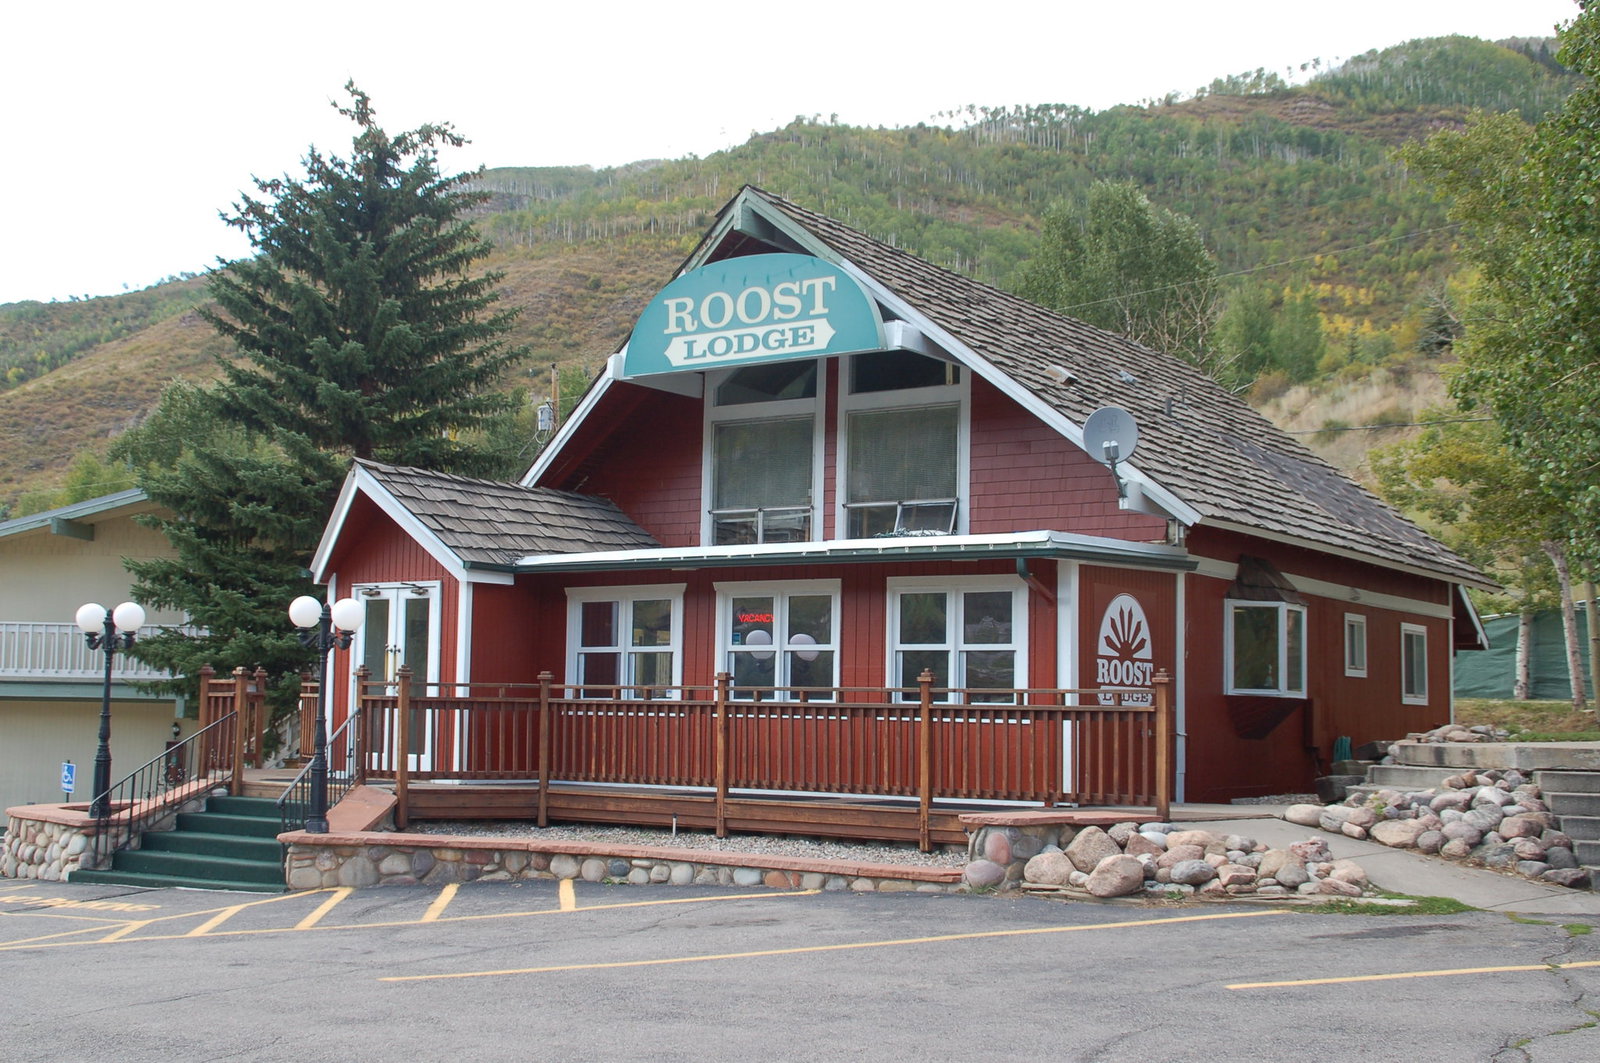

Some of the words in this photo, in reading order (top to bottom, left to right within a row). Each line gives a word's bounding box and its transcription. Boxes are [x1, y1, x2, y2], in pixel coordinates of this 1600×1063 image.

[663, 275, 836, 335] ROOST
[683, 325, 815, 360] LODGE
[1096, 658, 1153, 685] ROOST
[1103, 692, 1149, 702] LDGE
